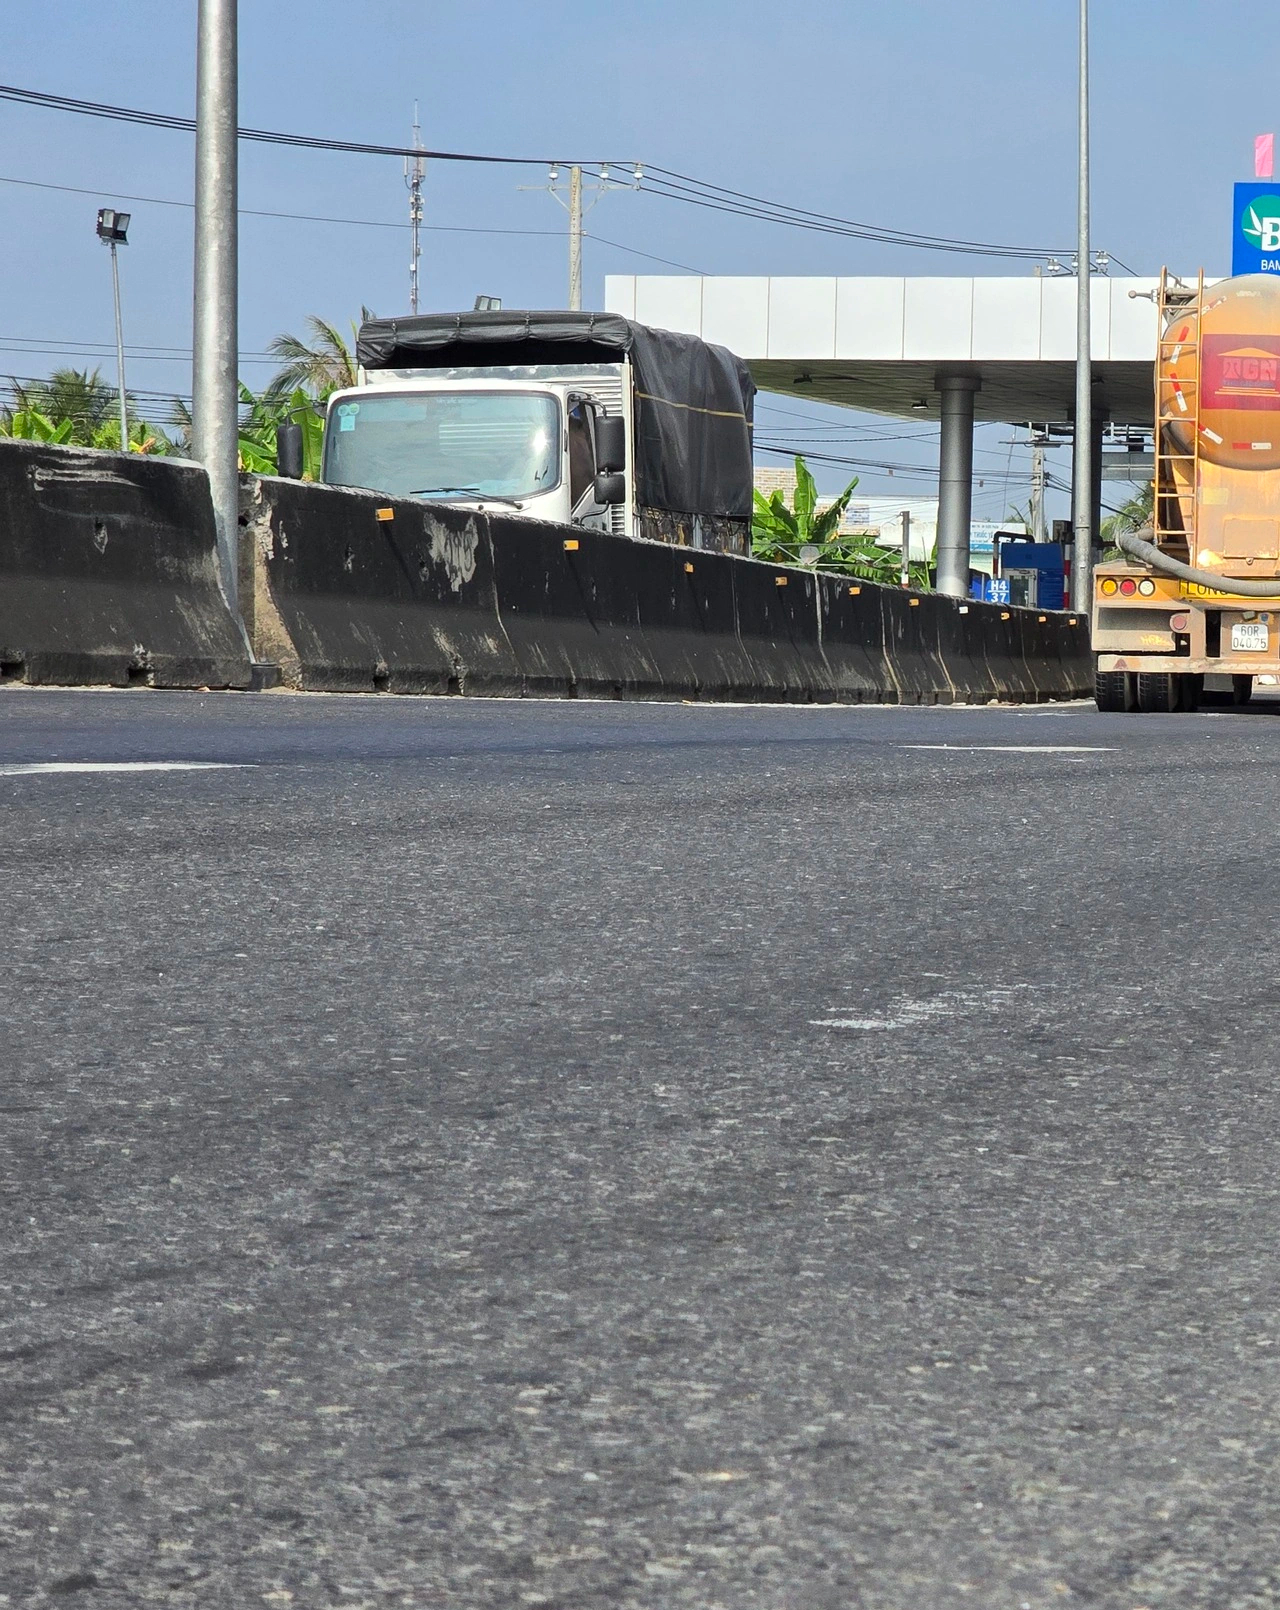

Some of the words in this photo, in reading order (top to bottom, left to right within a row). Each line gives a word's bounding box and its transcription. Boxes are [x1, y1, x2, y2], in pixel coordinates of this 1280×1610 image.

[991, 580, 1007, 590] H4
[991, 593, 1006, 602] 37
[1241, 626, 1259, 637] 60R
[1233, 638, 1267, 649] 040.75
